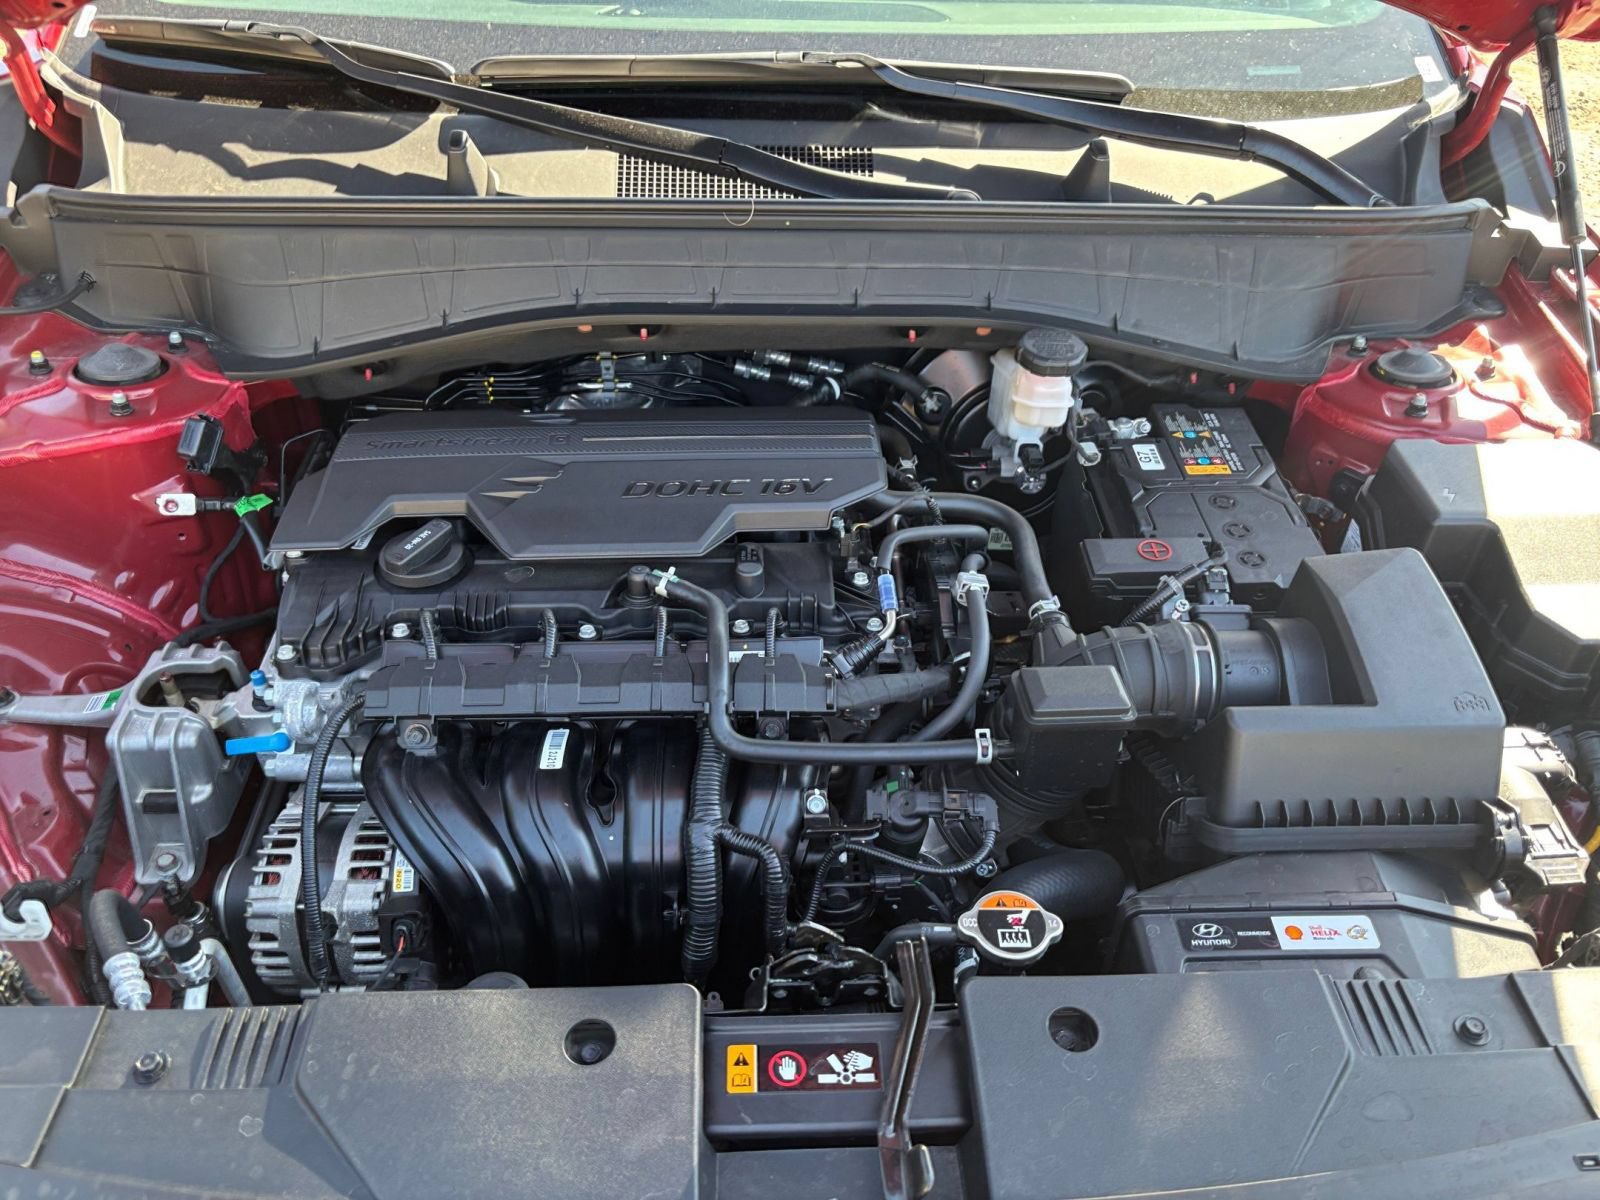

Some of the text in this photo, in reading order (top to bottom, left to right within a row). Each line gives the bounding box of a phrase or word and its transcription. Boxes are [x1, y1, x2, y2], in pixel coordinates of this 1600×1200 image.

[1137, 451, 1153, 463] G7
[621, 477, 834, 499] DOHC 16V
